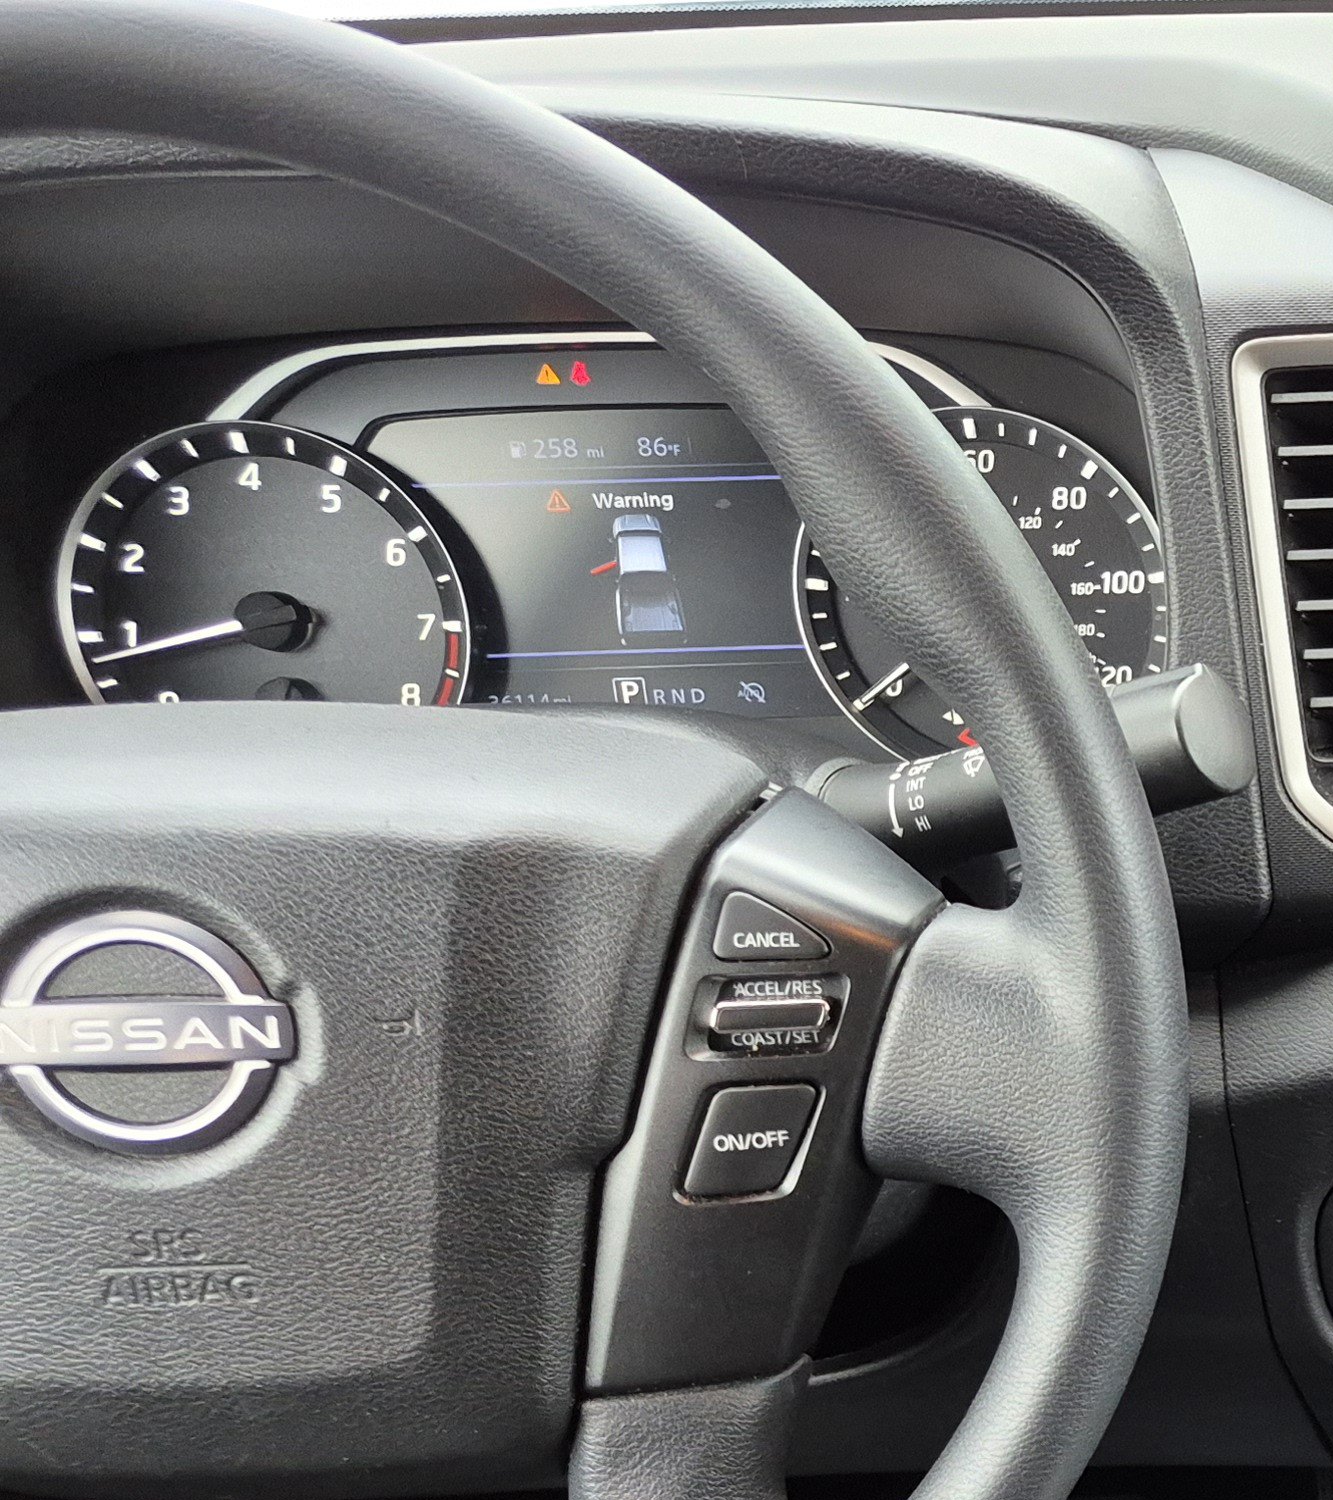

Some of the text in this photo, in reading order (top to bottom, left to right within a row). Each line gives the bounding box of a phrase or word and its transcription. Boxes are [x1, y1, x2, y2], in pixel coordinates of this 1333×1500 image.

[533, 438, 578, 459] 258
[239, 465, 261, 490] 4
[167, 487, 190, 514] 3
[320, 485, 341, 513] 5
[592, 492, 674, 511] Warning
[1051, 486, 1087, 510] 80
[1018, 516, 1042, 529] 120
[121, 544, 145, 573] 2
[386, 539, 407, 566] 6
[1052, 543, 1075, 557] 140
[1071, 582, 1094, 595] 160
[1100, 570, 1145, 594] 100
[122, 621, 138, 647] 1
[417, 614, 436, 641] 7
[1094, 665, 1133, 687] 20
[621, 681, 705, 705] P R N D
[908, 762, 934, 776] OFF
[906, 777, 926, 792] INT
[908, 795, 924, 811] LO
[915, 815, 932, 831] HI
[733, 932, 800, 949] CANCEL
[734, 980, 822, 996] ACCEL/RES
[731, 1030, 820, 1046] COAST/SET
[714, 1130, 789, 1152] ON/OFF
